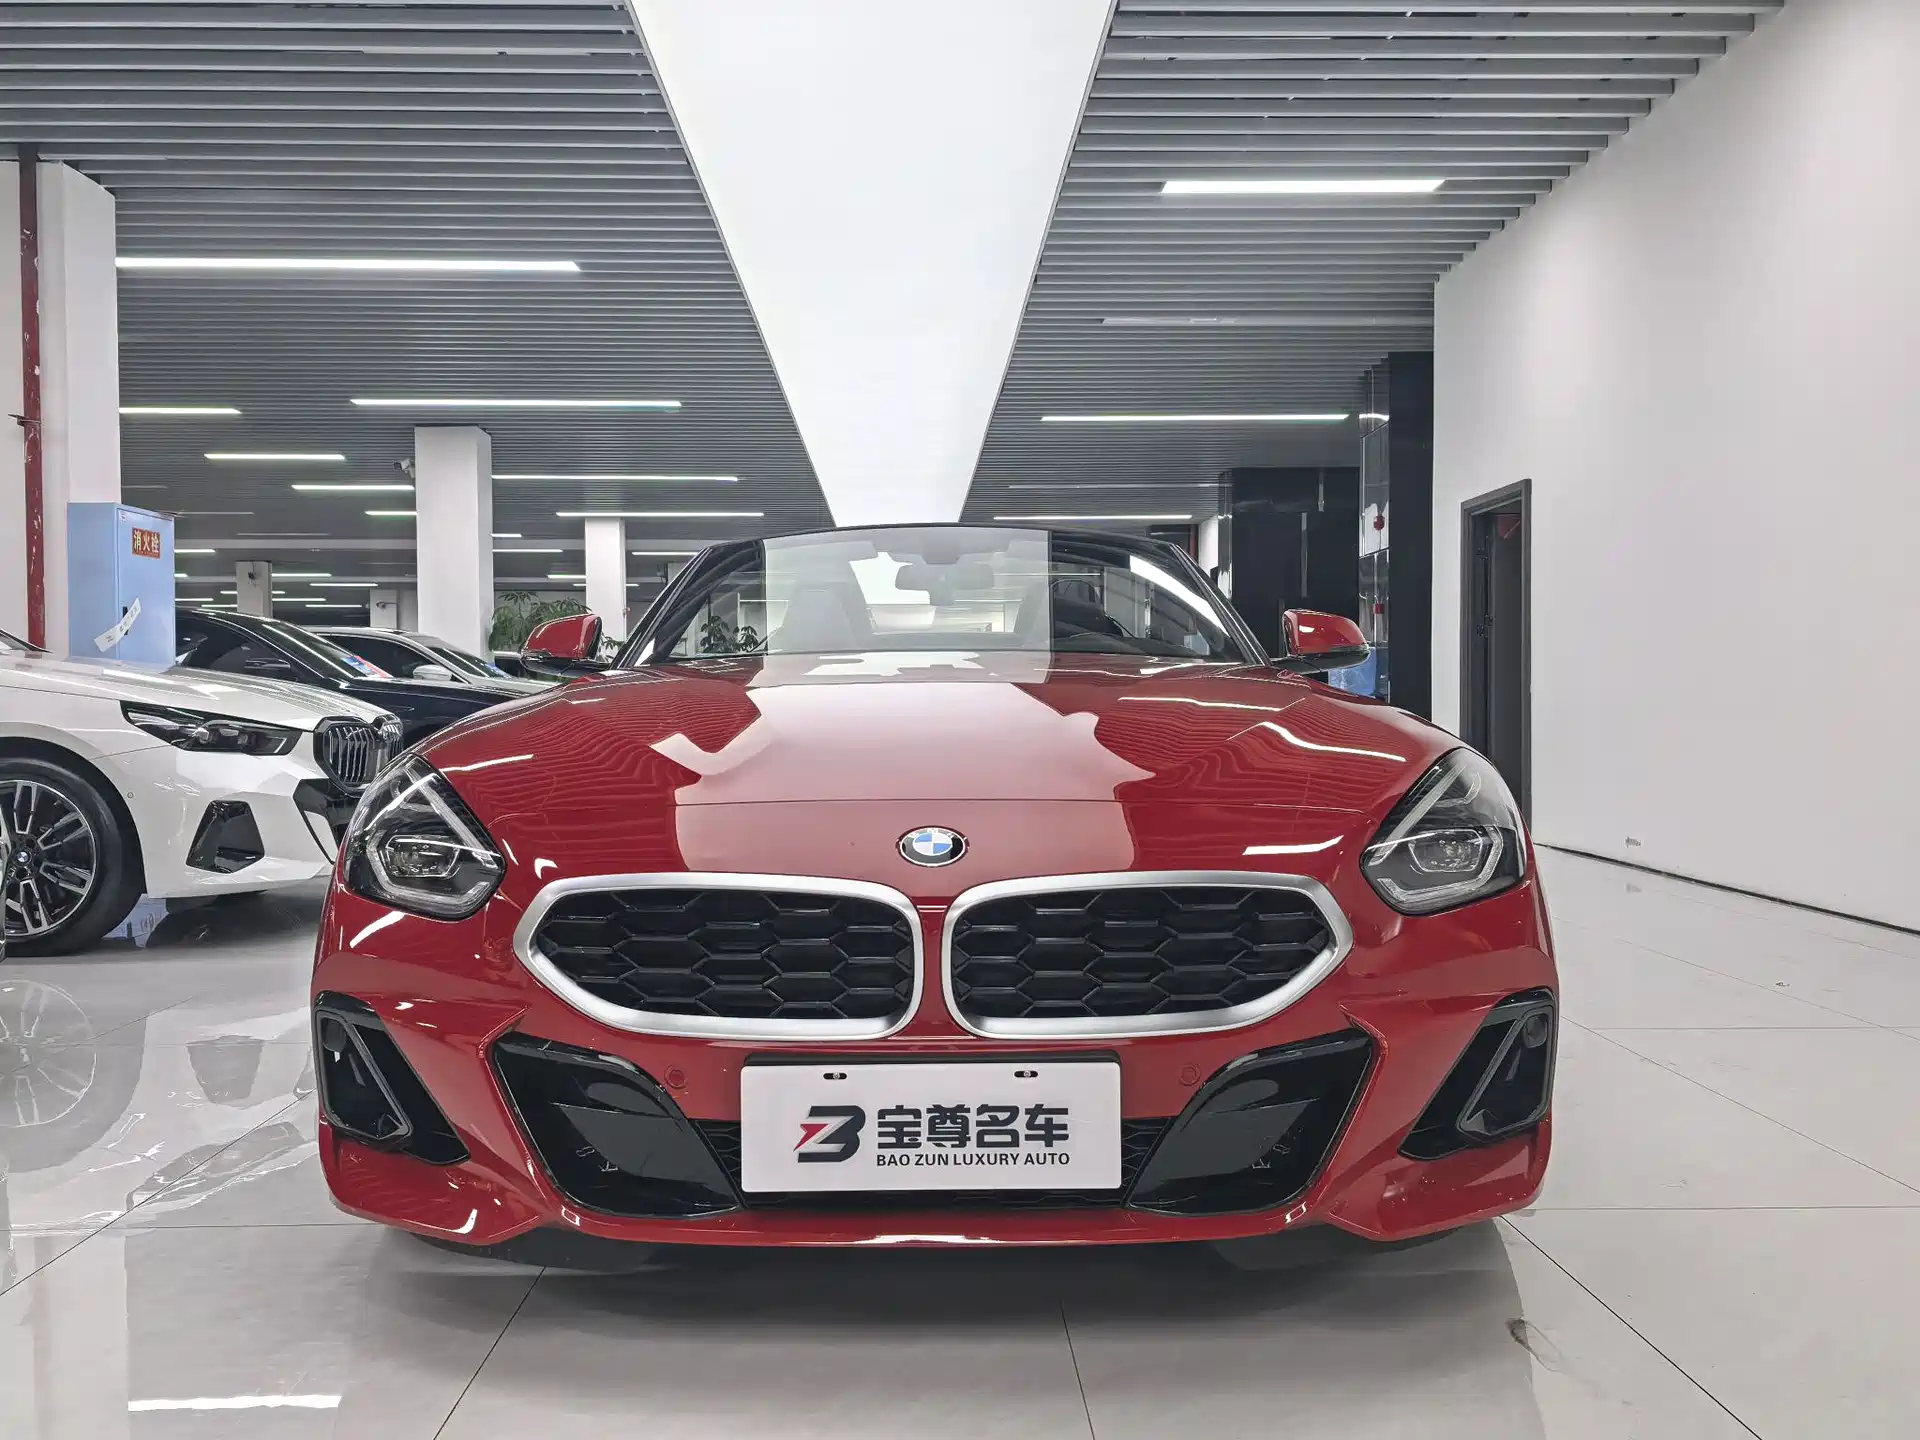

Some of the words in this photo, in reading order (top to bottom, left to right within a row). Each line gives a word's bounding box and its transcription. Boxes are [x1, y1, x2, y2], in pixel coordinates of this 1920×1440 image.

[133, 529, 159, 553] 消火栓
[877, 1103, 1069, 1149] 宝尊名车
[876, 1154, 910, 1167] BAO
[914, 1153, 949, 1166] ZUN
[953, 1153, 1020, 1165] LUXURY
[1024, 1152, 1070, 1165] AUTO
